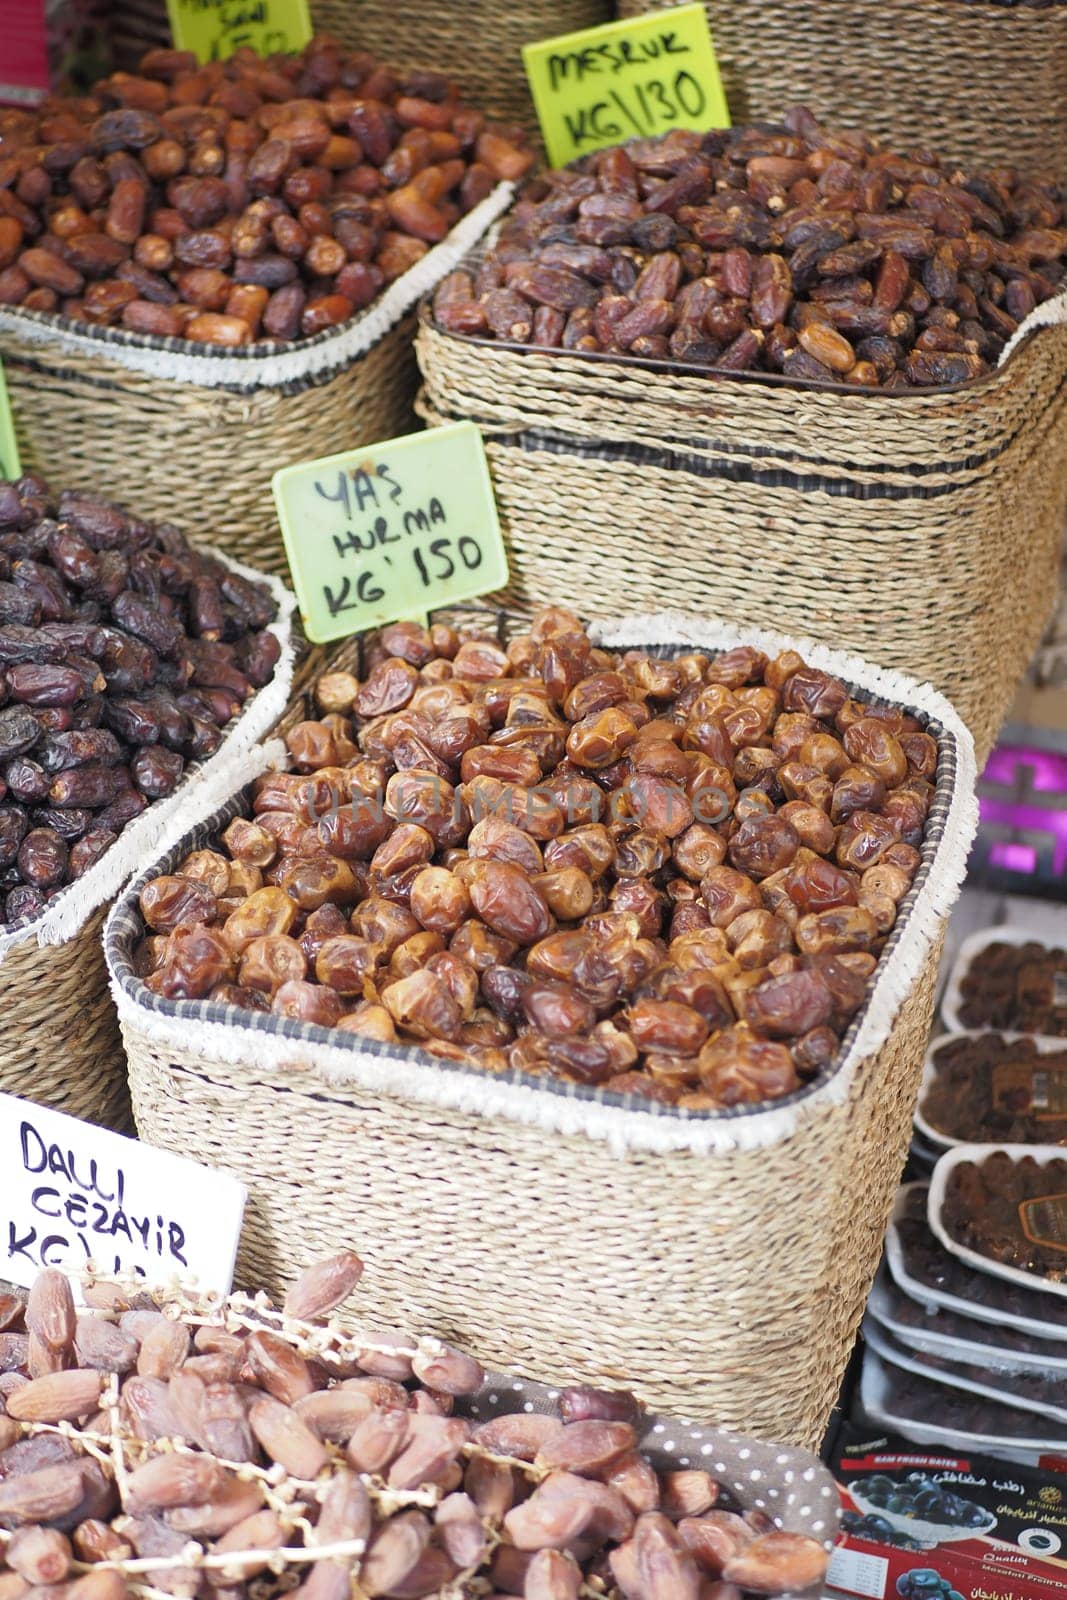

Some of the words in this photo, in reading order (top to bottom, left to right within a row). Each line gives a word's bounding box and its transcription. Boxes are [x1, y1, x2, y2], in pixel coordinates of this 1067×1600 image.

[332, 496, 446, 559] HURMA
[412, 535, 482, 587] 150
[897, 1456, 927, 1466] FRESH
[928, 1457, 959, 1469] DATES
